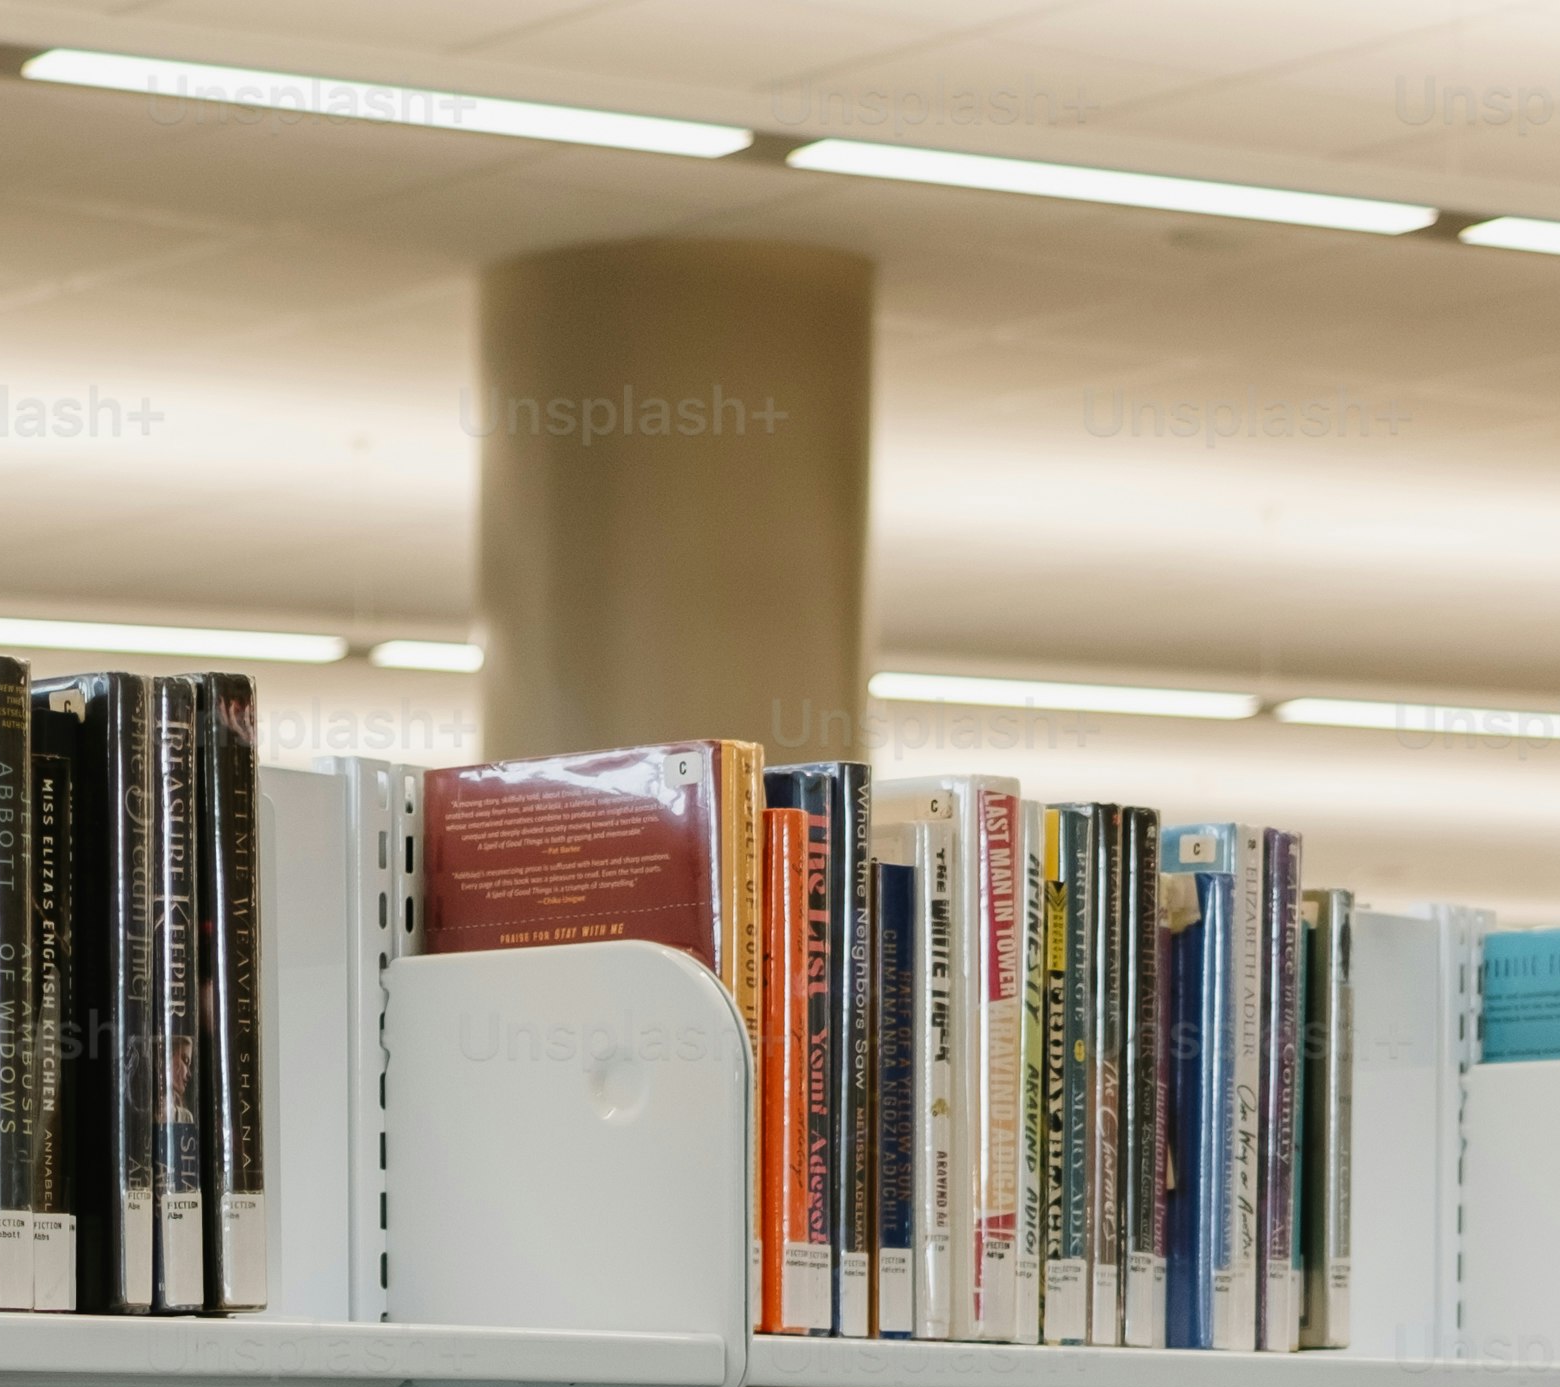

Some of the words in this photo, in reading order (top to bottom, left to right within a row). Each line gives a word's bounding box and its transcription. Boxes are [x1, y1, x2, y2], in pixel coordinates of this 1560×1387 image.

[42, 779, 54, 826] MISS
[981, 792, 1010, 838] LAST
[987, 844, 1013, 893] MAN
[993, 898, 1014, 922] IN
[42, 920, 55, 1010] ENGLISH
[995, 928, 1018, 1000] TOWER
[43, 1019, 55, 1111] KITCHEN
